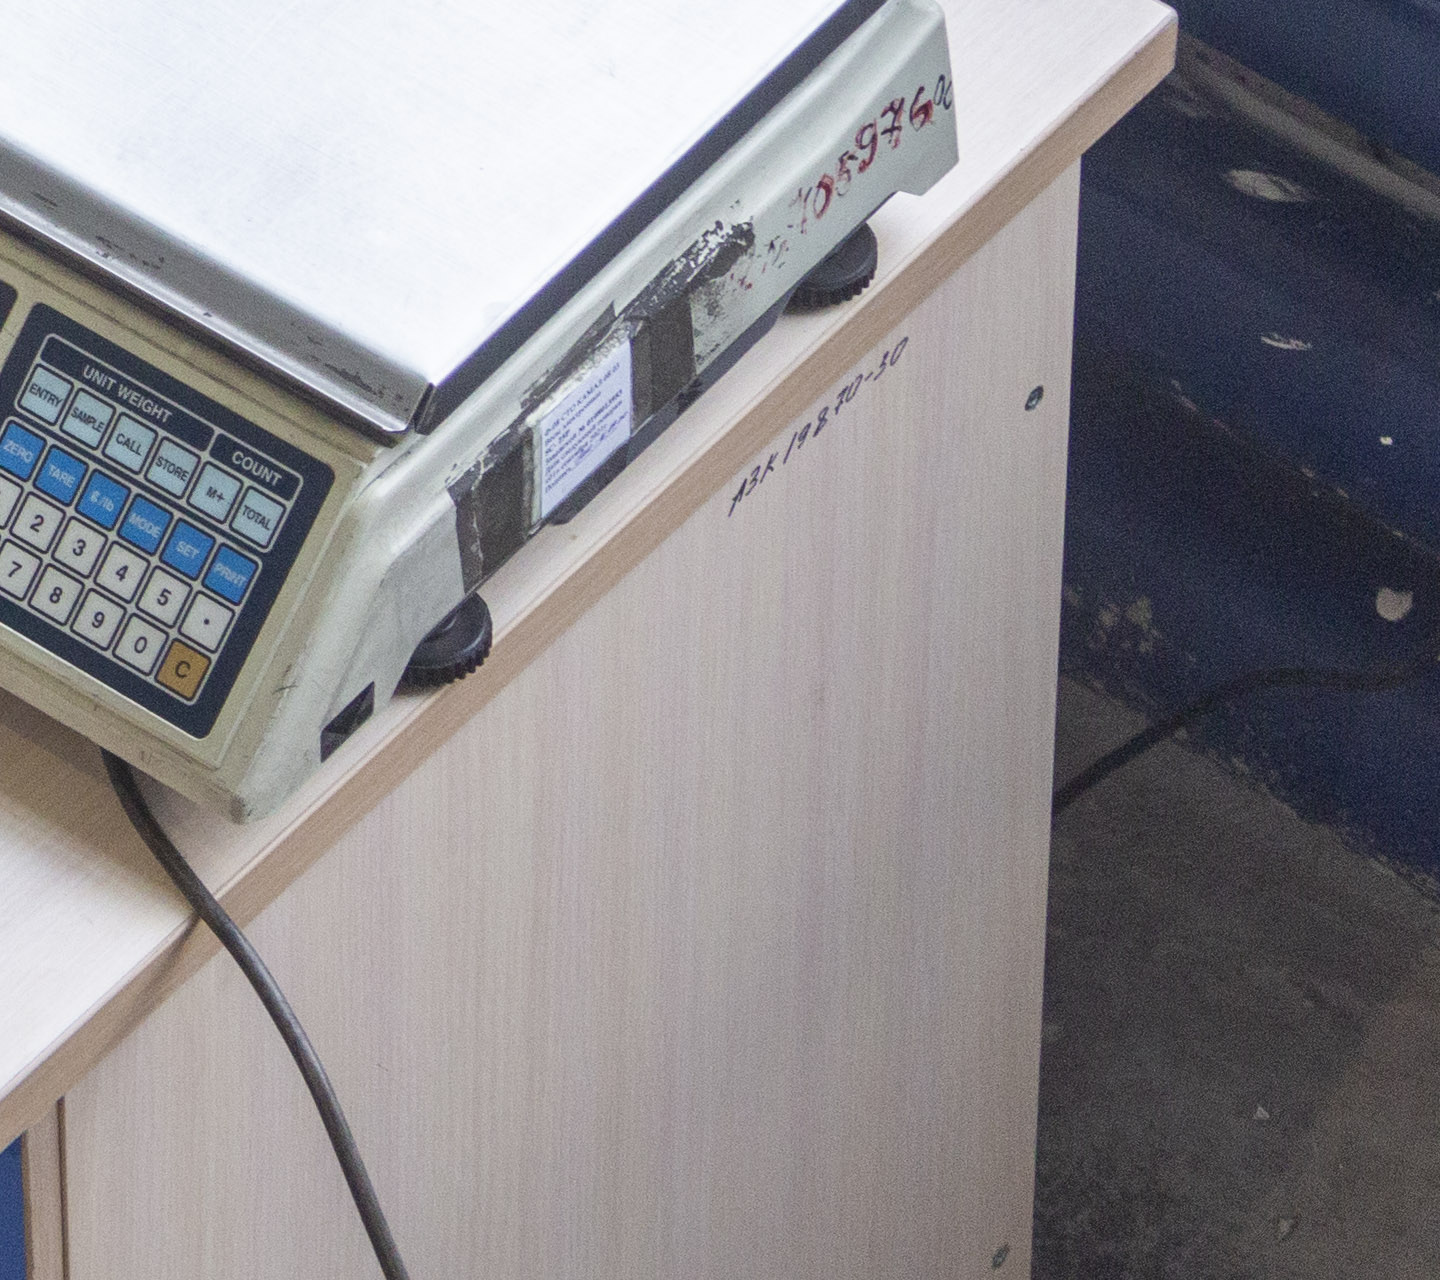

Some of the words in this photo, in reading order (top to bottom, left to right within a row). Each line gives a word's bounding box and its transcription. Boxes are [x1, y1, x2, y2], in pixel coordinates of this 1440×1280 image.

[29, 384, 61, 408] ENTRY
[82, 366, 115, 391] UNIT
[116, 385, 171, 423] WEIGHT
[71, 408, 104, 431] SAMPLE
[4, 440, 32, 462] ZERO
[115, 433, 143, 454] CALL
[47, 465, 73, 487] TARE
[156, 457, 188, 480] STORE
[231, 451, 281, 486] COUNT
[206, 487, 225, 503] M+
[30, 514, 44, 531] 2
[129, 514, 159, 537] MODE
[241, 505, 272, 529] TOTAL
[72, 539, 86, 556] 3
[176, 541, 198, 559] SET
[7, 562, 20, 578] 7
[114, 564, 128, 581] 4
[214, 563, 245, 587] PRINT
[49, 587, 62, 603] 8
[157, 589, 170, 606] 5
[91, 611, 105, 629] 9
[133, 636, 147, 654] 0
[174, 660, 190, 679] C
